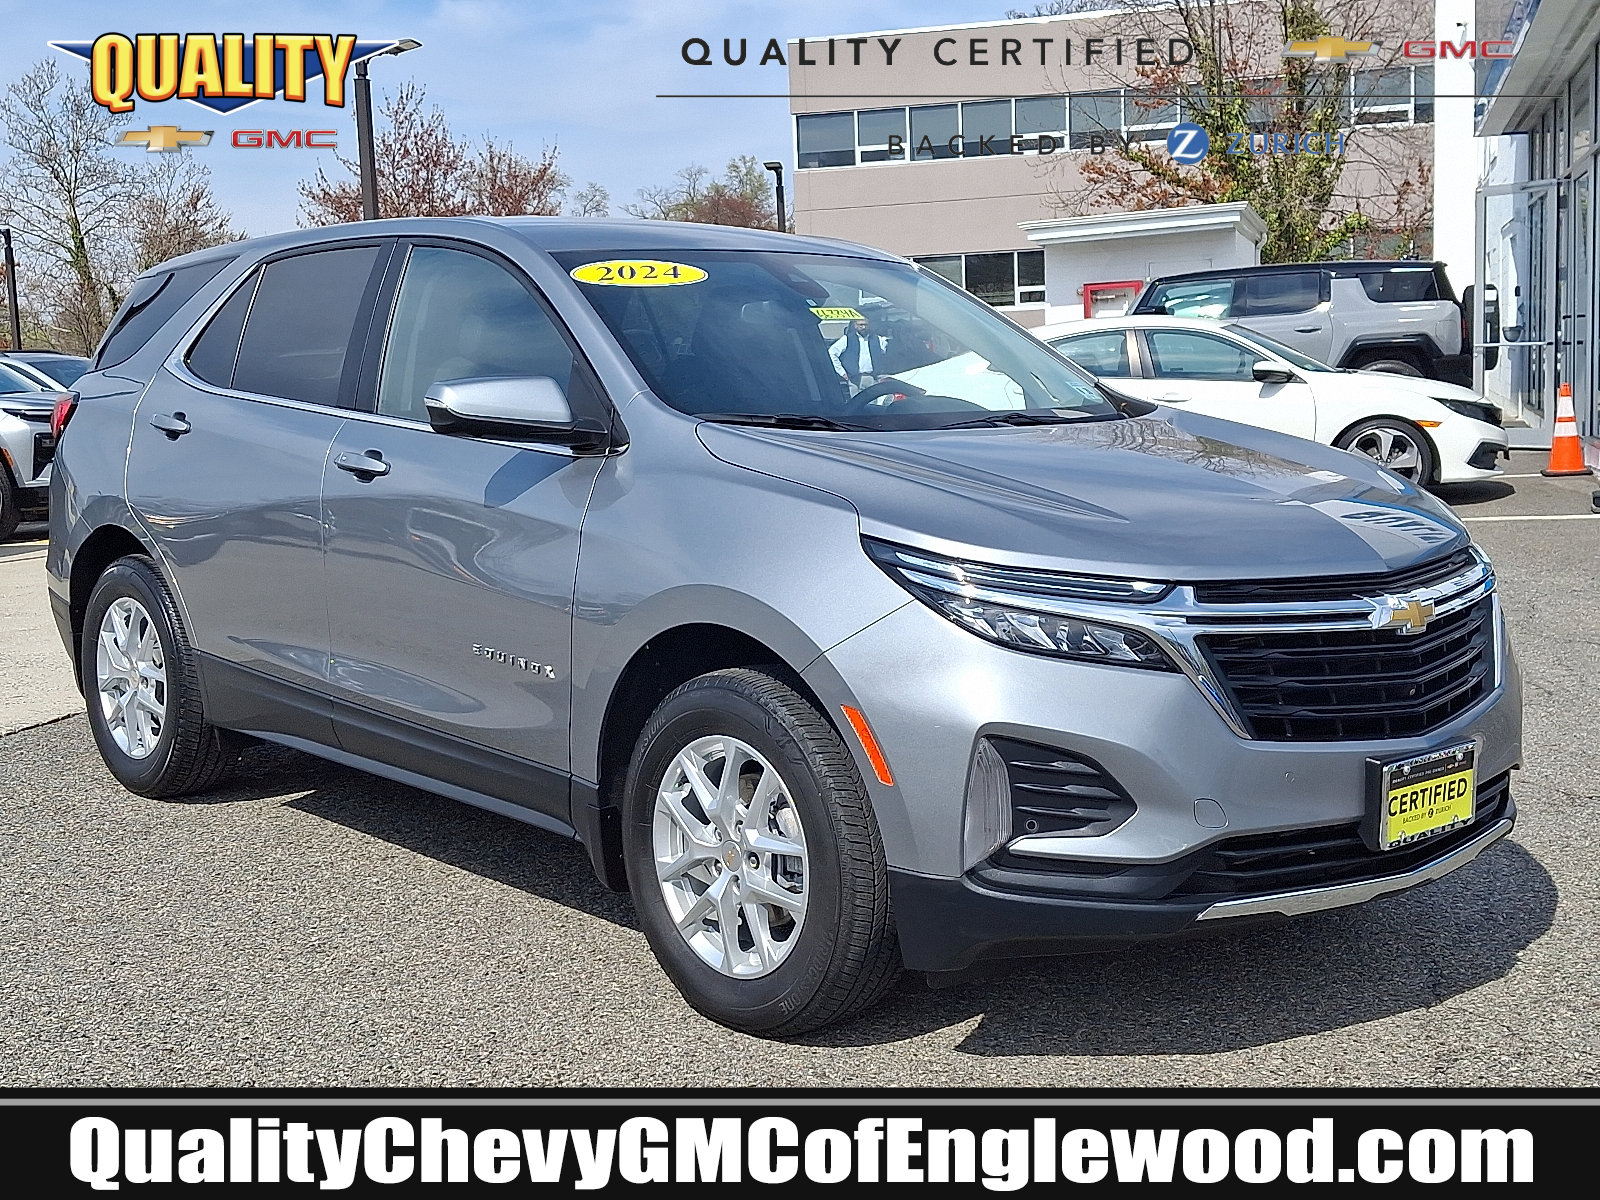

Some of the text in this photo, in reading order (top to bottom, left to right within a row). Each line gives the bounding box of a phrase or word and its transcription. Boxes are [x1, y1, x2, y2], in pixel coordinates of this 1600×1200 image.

[595, 264, 682, 282] 2024
[472, 643, 556, 679] EQUINOX
[1388, 778, 1467, 817] CERTIFIED
[1402, 813, 1421, 824] BACKED
[1388, 819, 1470, 848] QUALITY
